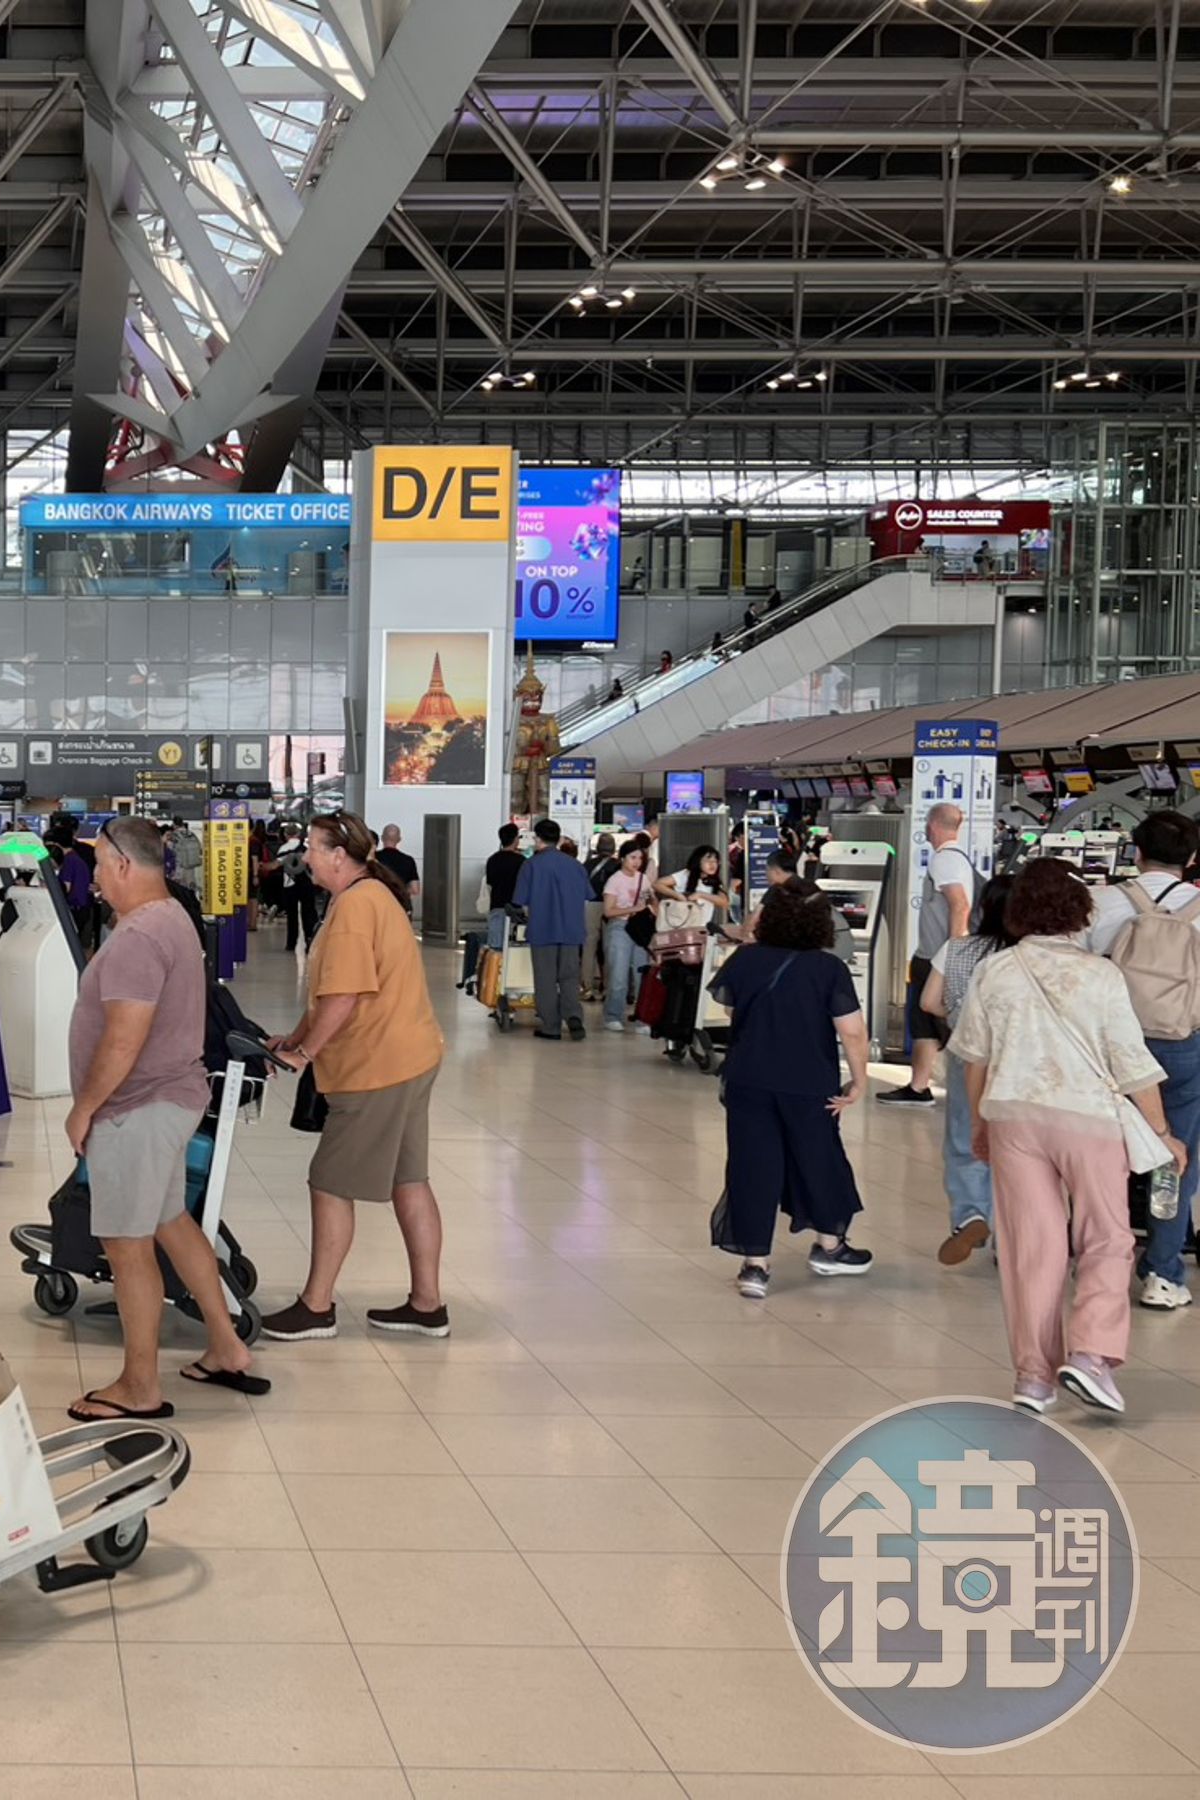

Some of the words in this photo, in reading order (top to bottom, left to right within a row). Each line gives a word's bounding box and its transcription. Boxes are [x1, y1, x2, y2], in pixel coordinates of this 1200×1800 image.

[383, 467, 500, 519] D/E
[44, 503, 128, 519] BANGKOK
[132, 503, 212, 519] AIRWAYS
[226, 503, 285, 519] TICKET
[290, 503, 349, 519] OFFICE
[926, 510, 956, 519] SALES
[958, 510, 1003, 519] COUNTER
[525, 565, 547, 577] ON
[551, 565, 578, 577] TOP
[929, 728, 958, 737] EASY
[917, 739, 970, 748] CHECK-IN
[163, 748, 178, 760] Y1
[57, 757, 88, 765] Oversize
[90, 757, 120, 766] Baggage
[218, 850, 227, 874] BAG
[234, 847, 242, 871] BAG
[218, 876, 227, 906] DROP
[234, 873, 242, 897] DROP
